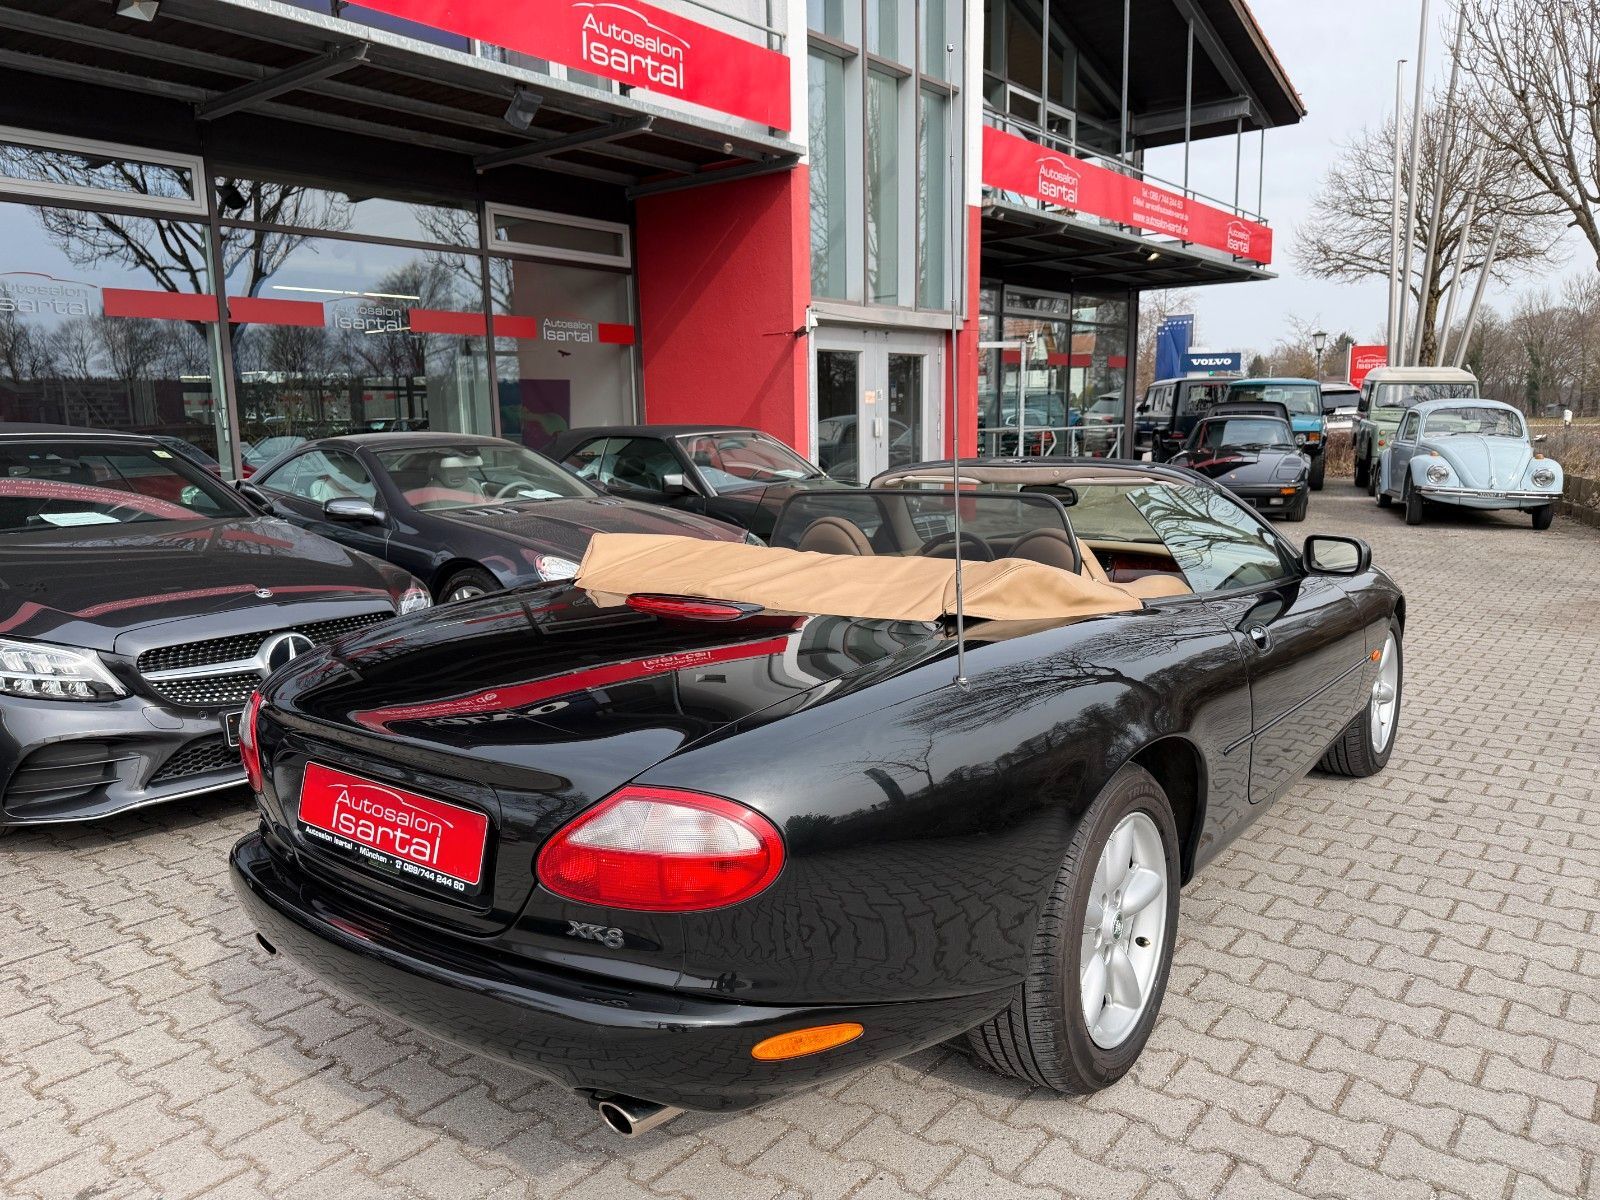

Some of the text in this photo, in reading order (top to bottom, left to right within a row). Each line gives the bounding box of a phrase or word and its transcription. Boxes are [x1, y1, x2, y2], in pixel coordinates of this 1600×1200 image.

[582, 13, 683, 61] Autosalon
[582, 30, 684, 90] Isartal
[1038, 175, 1078, 205] Isartal
[1039, 164, 1078, 186] Autosalon
[0, 297, 92, 316] sartal
[334, 313, 402, 332] Isartal
[543, 318, 593, 330] Autosalon
[543, 326, 593, 343] Isartal
[1191, 358, 1232, 366] VOLVO
[336, 789, 442, 838] Autosalon
[331, 803, 441, 865] Isartal
[305, 825, 333, 842] Autosalon
[334, 836, 353, 851] Isartal
[360, 846, 388, 865] München
[436, 874, 453, 887] 244
[453, 880, 465, 892] 60
[566, 920, 625, 950] XK8
